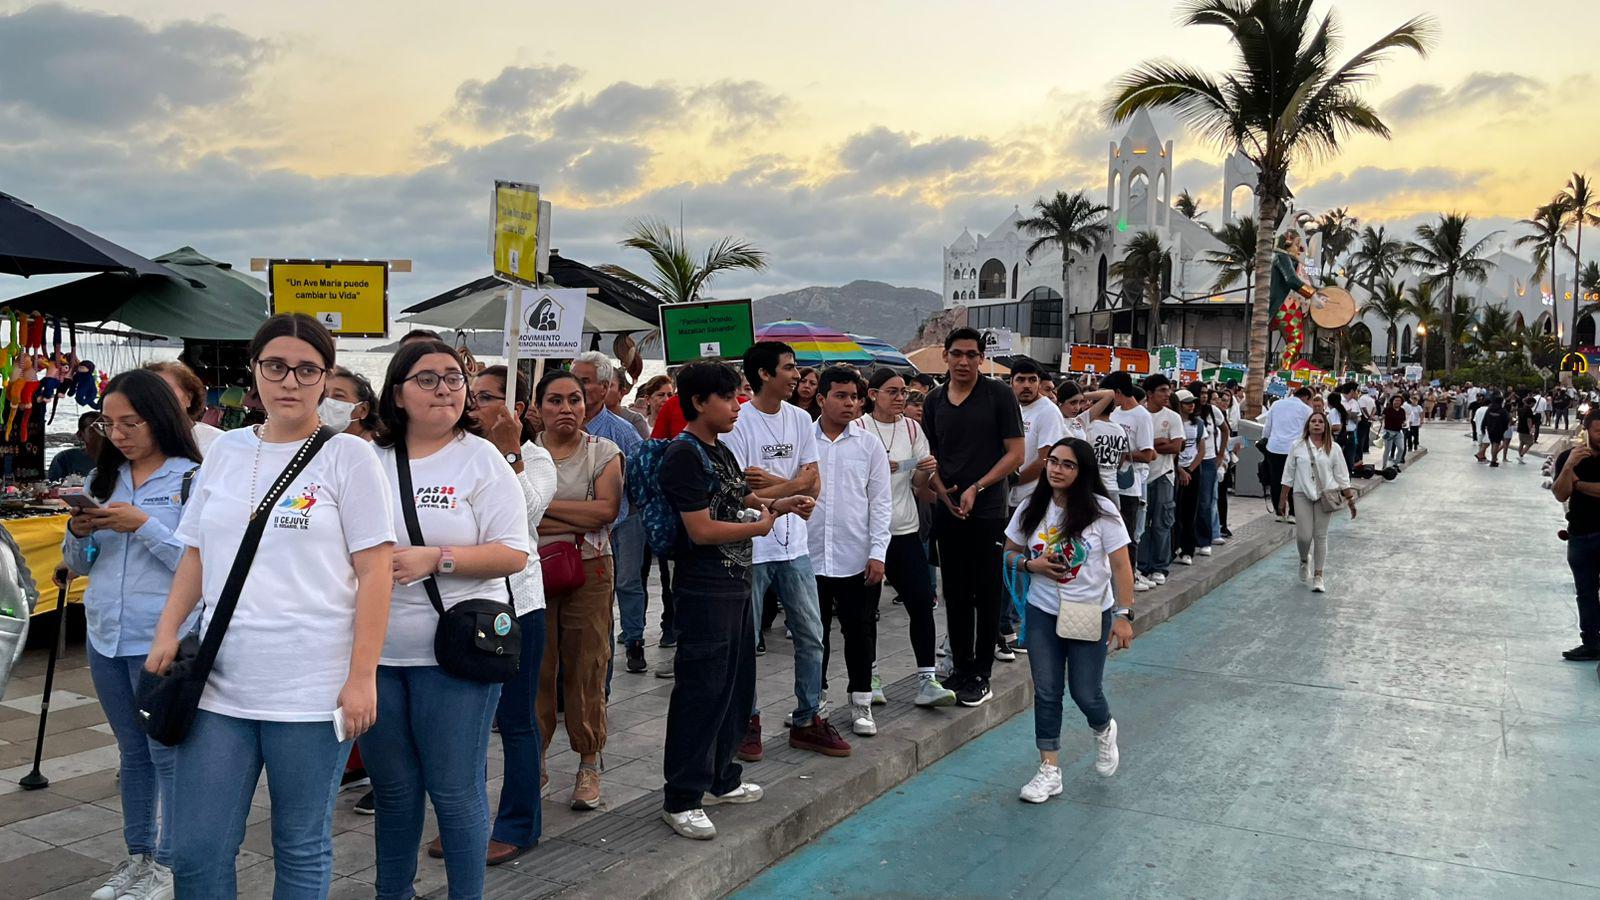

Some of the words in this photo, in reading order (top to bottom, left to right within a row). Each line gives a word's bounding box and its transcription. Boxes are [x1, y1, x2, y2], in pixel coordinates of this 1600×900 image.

[343, 280, 369, 288] puede
[338, 292, 361, 300] Vida"
[762, 444, 794, 453] VOLCOM
[421, 495, 449, 504] CUA
[280, 516, 309, 525] CEJUVE
